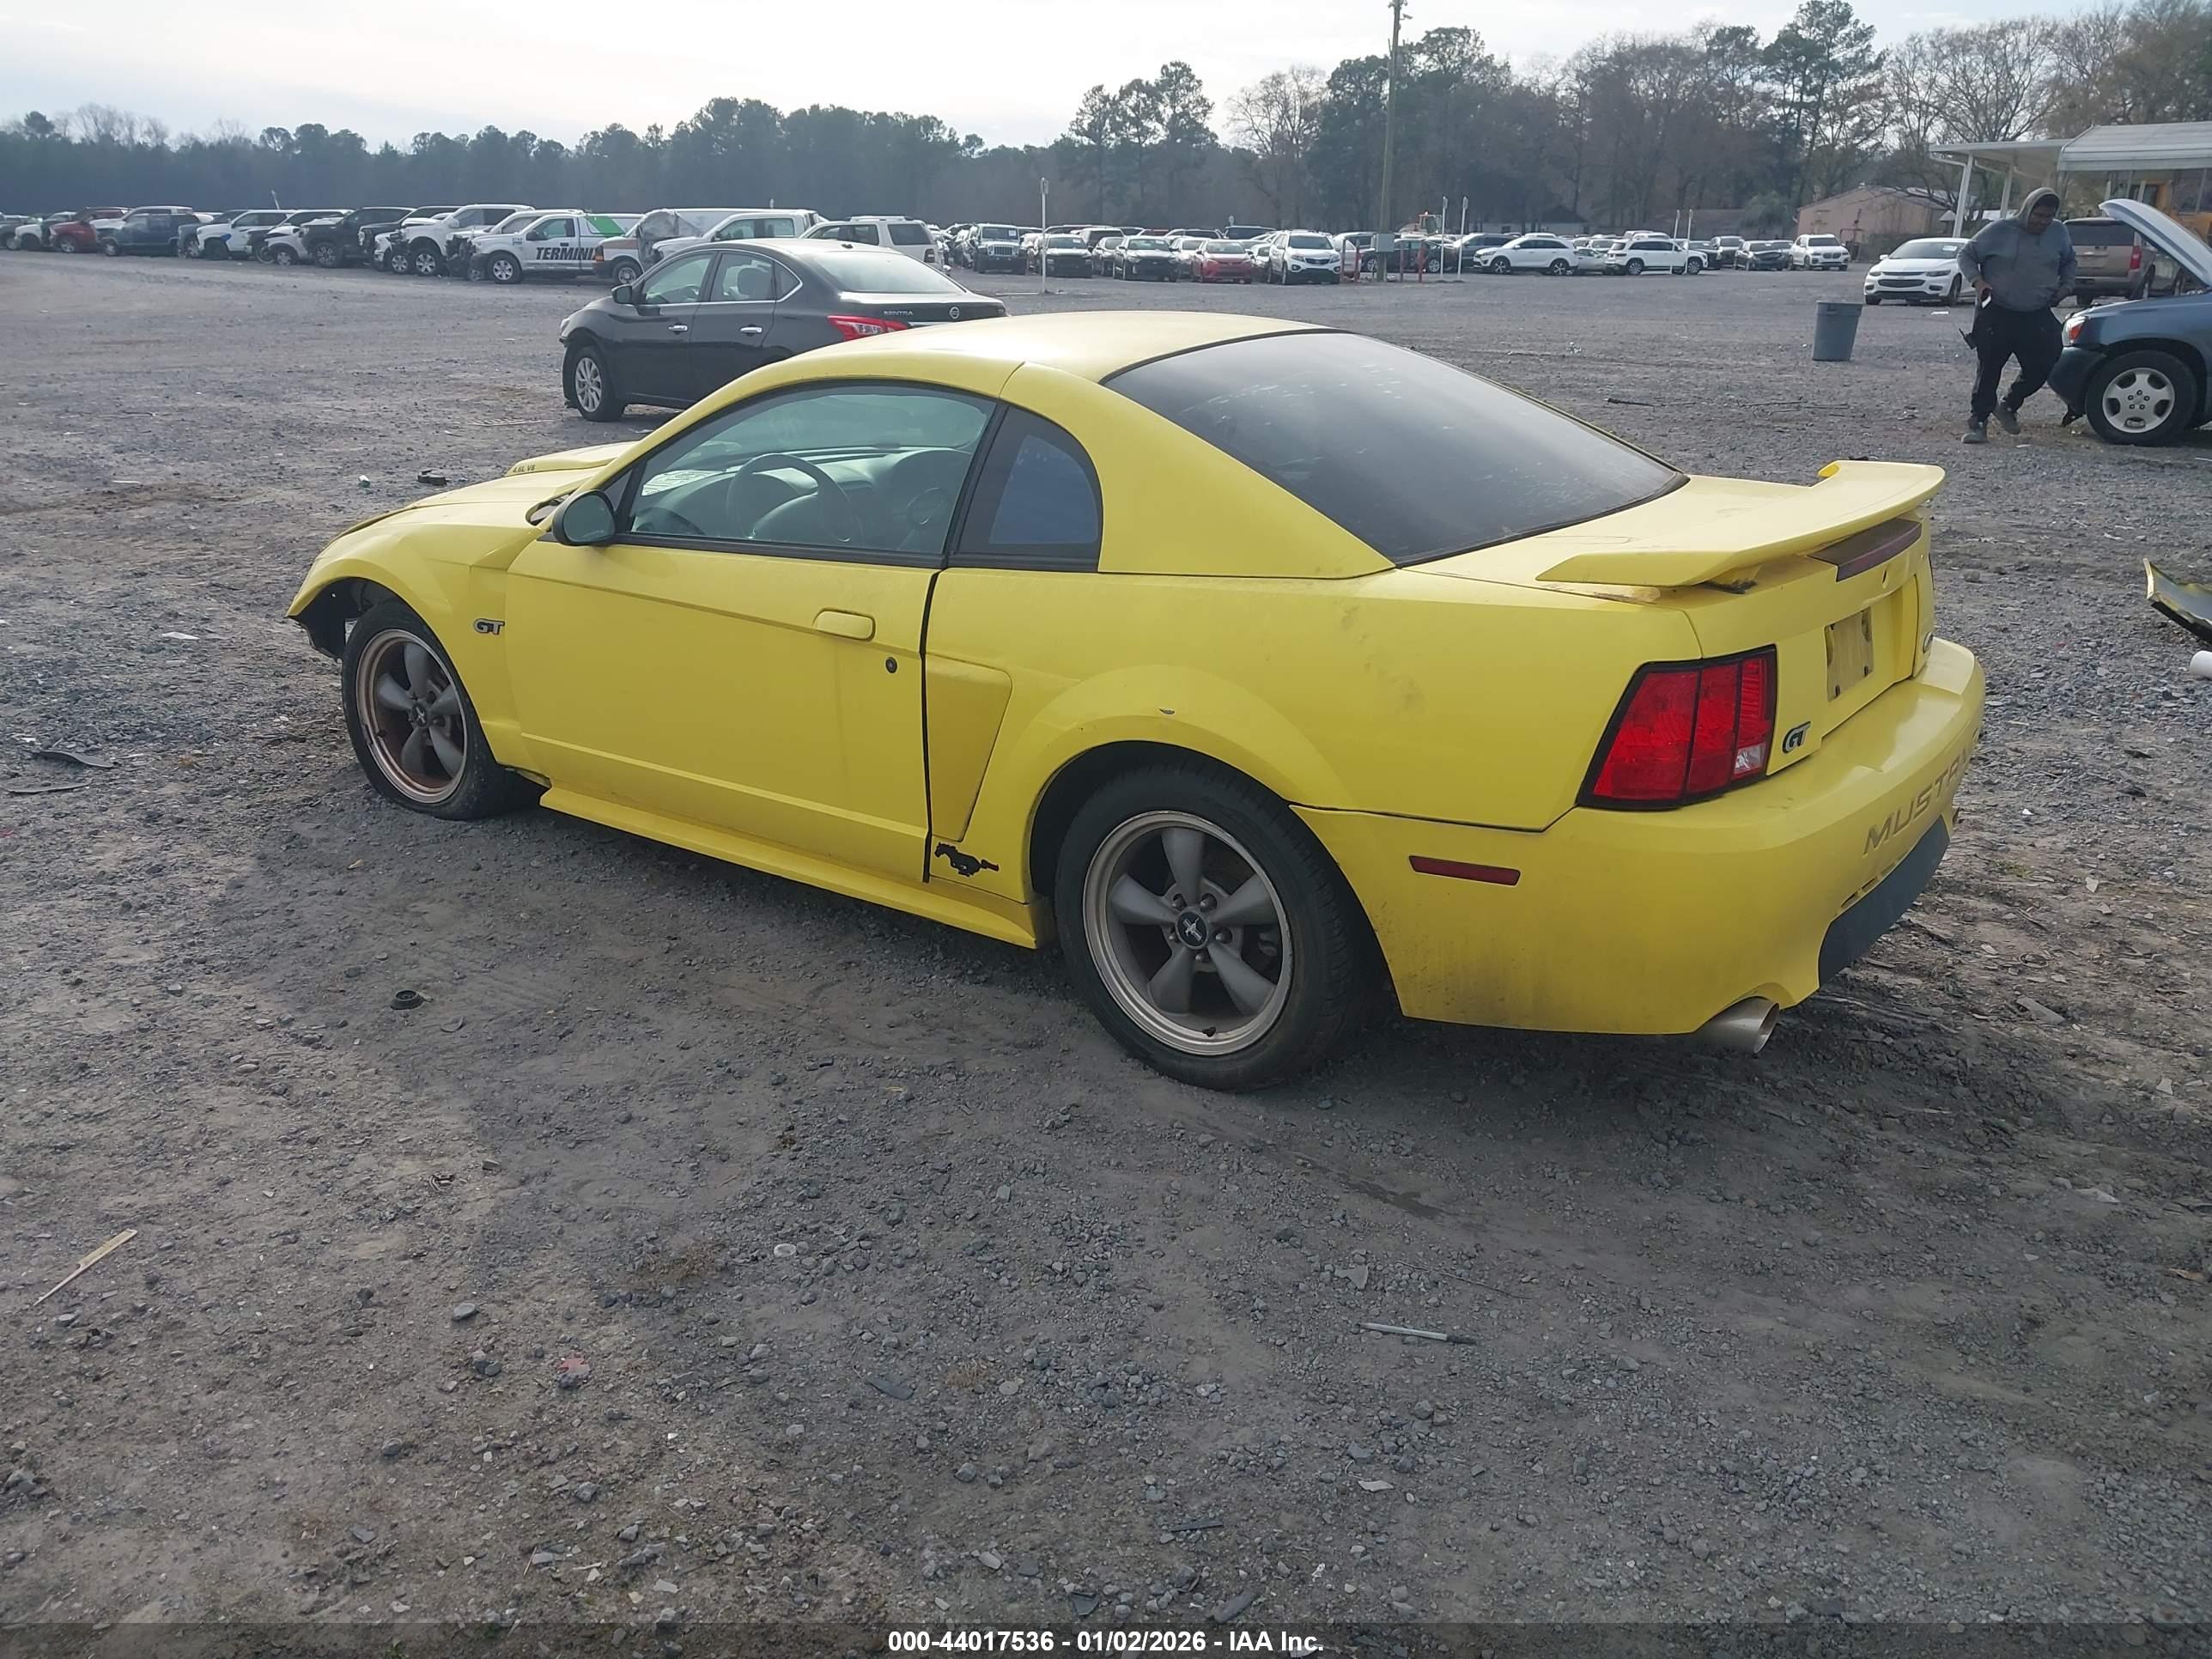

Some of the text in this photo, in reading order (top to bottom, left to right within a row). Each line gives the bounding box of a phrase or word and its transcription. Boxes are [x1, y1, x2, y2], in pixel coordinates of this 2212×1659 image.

[536, 247, 596, 260] TERMINI
[473, 618, 505, 635] GT
[1783, 721, 1811, 753] GT
